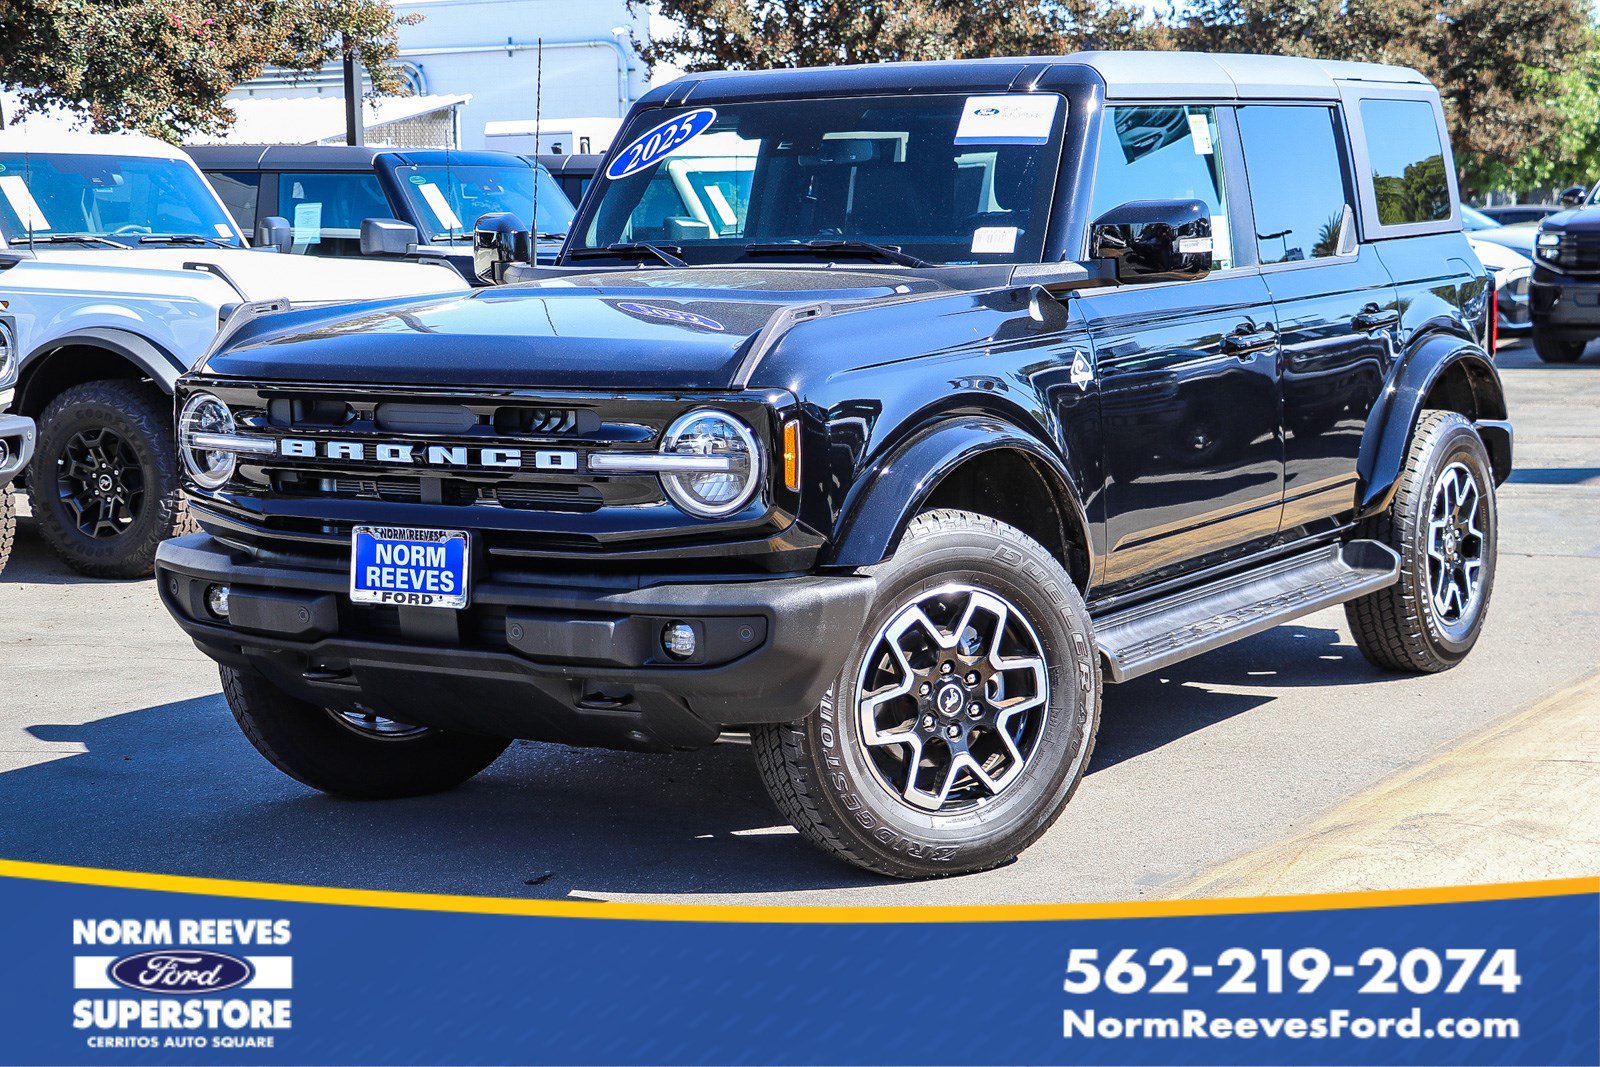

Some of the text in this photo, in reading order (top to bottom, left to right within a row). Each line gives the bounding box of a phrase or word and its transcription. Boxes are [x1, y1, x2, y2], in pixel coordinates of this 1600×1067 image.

[622, 113, 698, 174] 2025
[280, 438, 579, 470] BRONCO
[380, 527, 440, 542] NORM REEVES
[375, 543, 446, 568] NORM
[366, 565, 455, 592] REEVES
[382, 592, 434, 605] FORD
[992, 545, 1092, 693] DUELER
